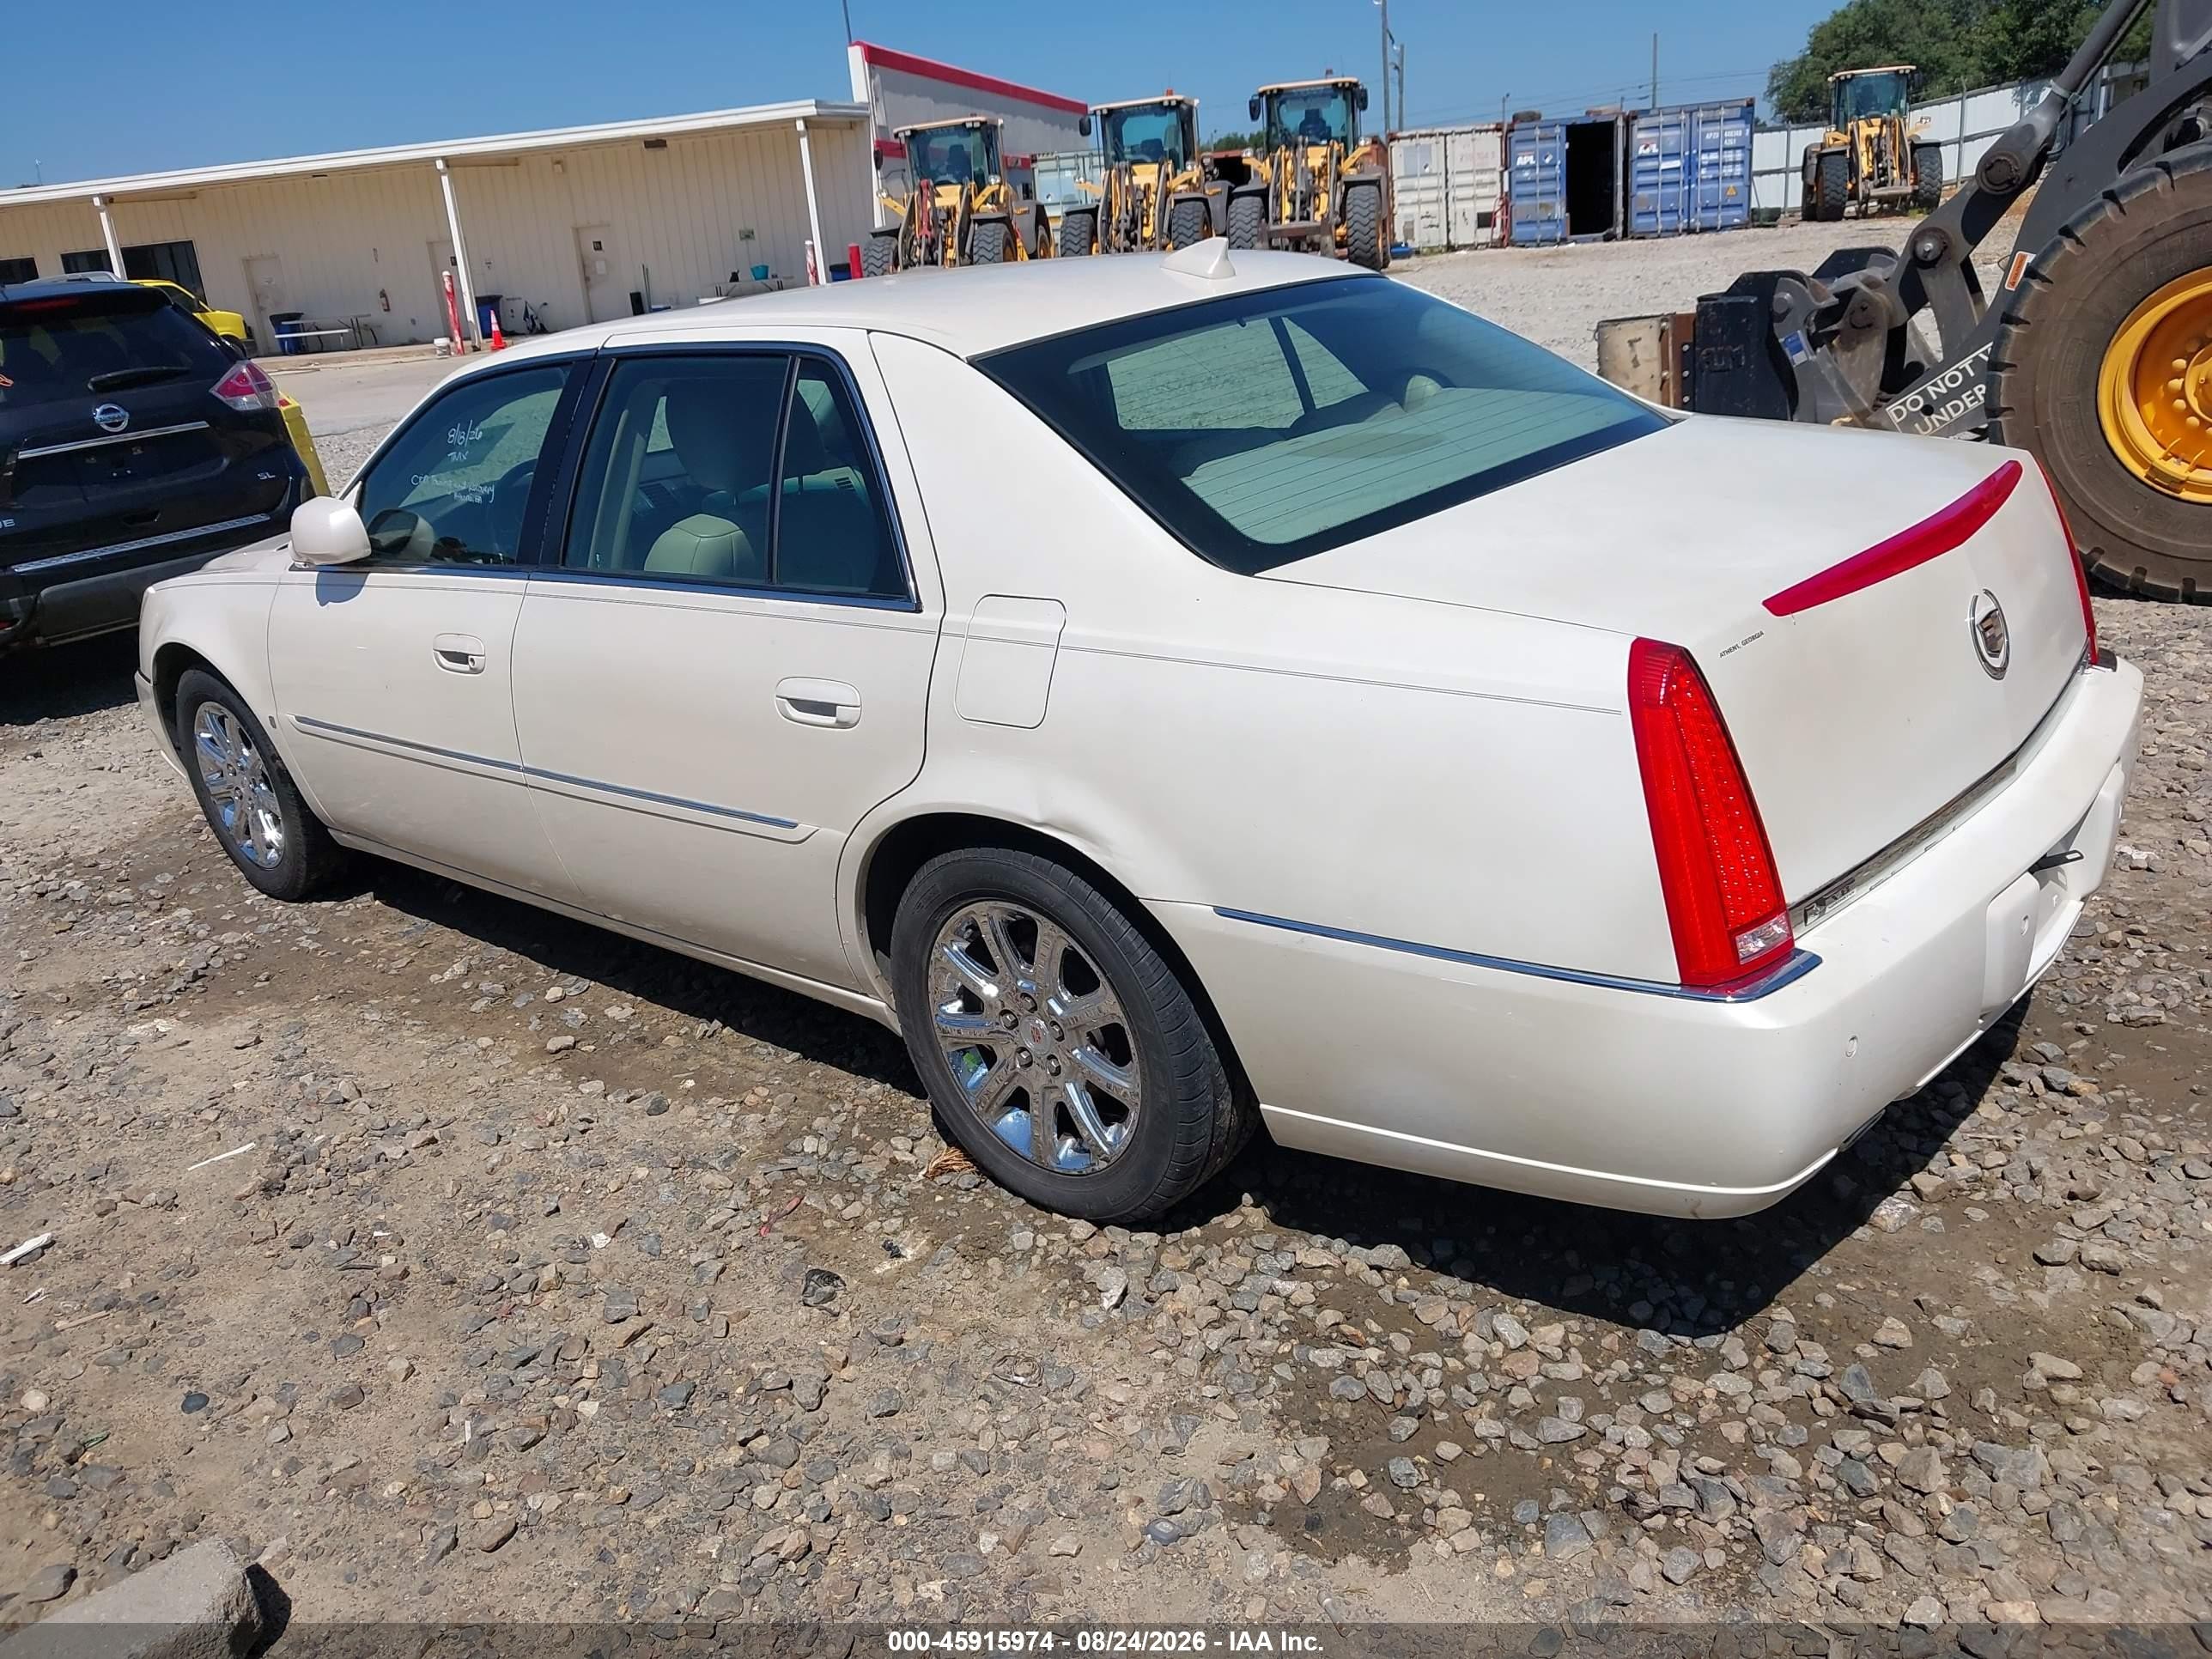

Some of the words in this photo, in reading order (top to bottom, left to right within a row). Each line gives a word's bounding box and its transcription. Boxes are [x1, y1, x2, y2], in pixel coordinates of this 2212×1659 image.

[1889, 395, 1924, 423] DO
[1926, 359, 1975, 401] NOT
[258, 471, 276, 480] SL
[1741, 630, 1765, 647] GEORGIA
